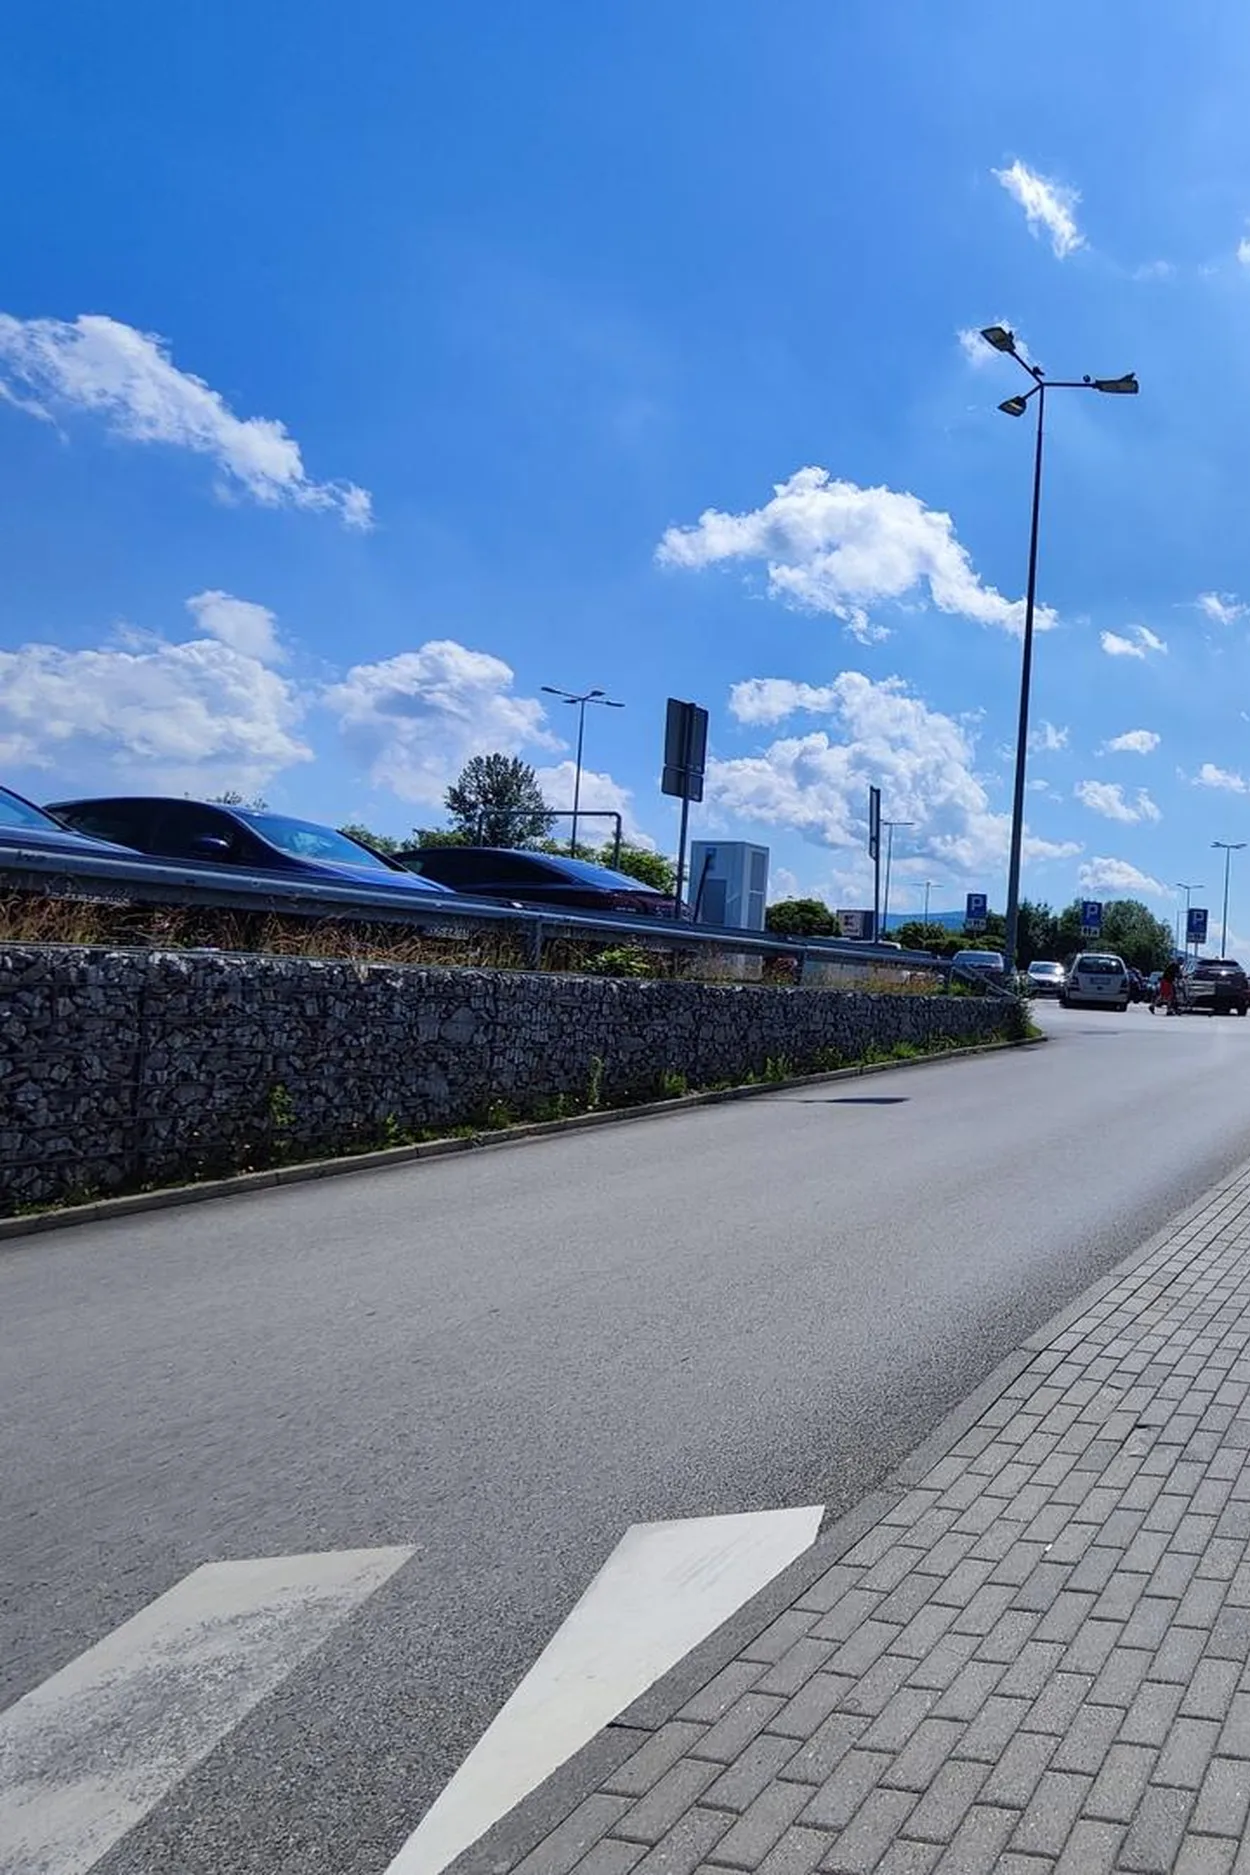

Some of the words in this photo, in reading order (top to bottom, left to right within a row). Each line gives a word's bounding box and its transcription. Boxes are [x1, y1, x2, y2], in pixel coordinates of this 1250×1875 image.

[972, 896, 984, 910] P
[1086, 904, 1099, 919] P
[1192, 911, 1205, 925] P
